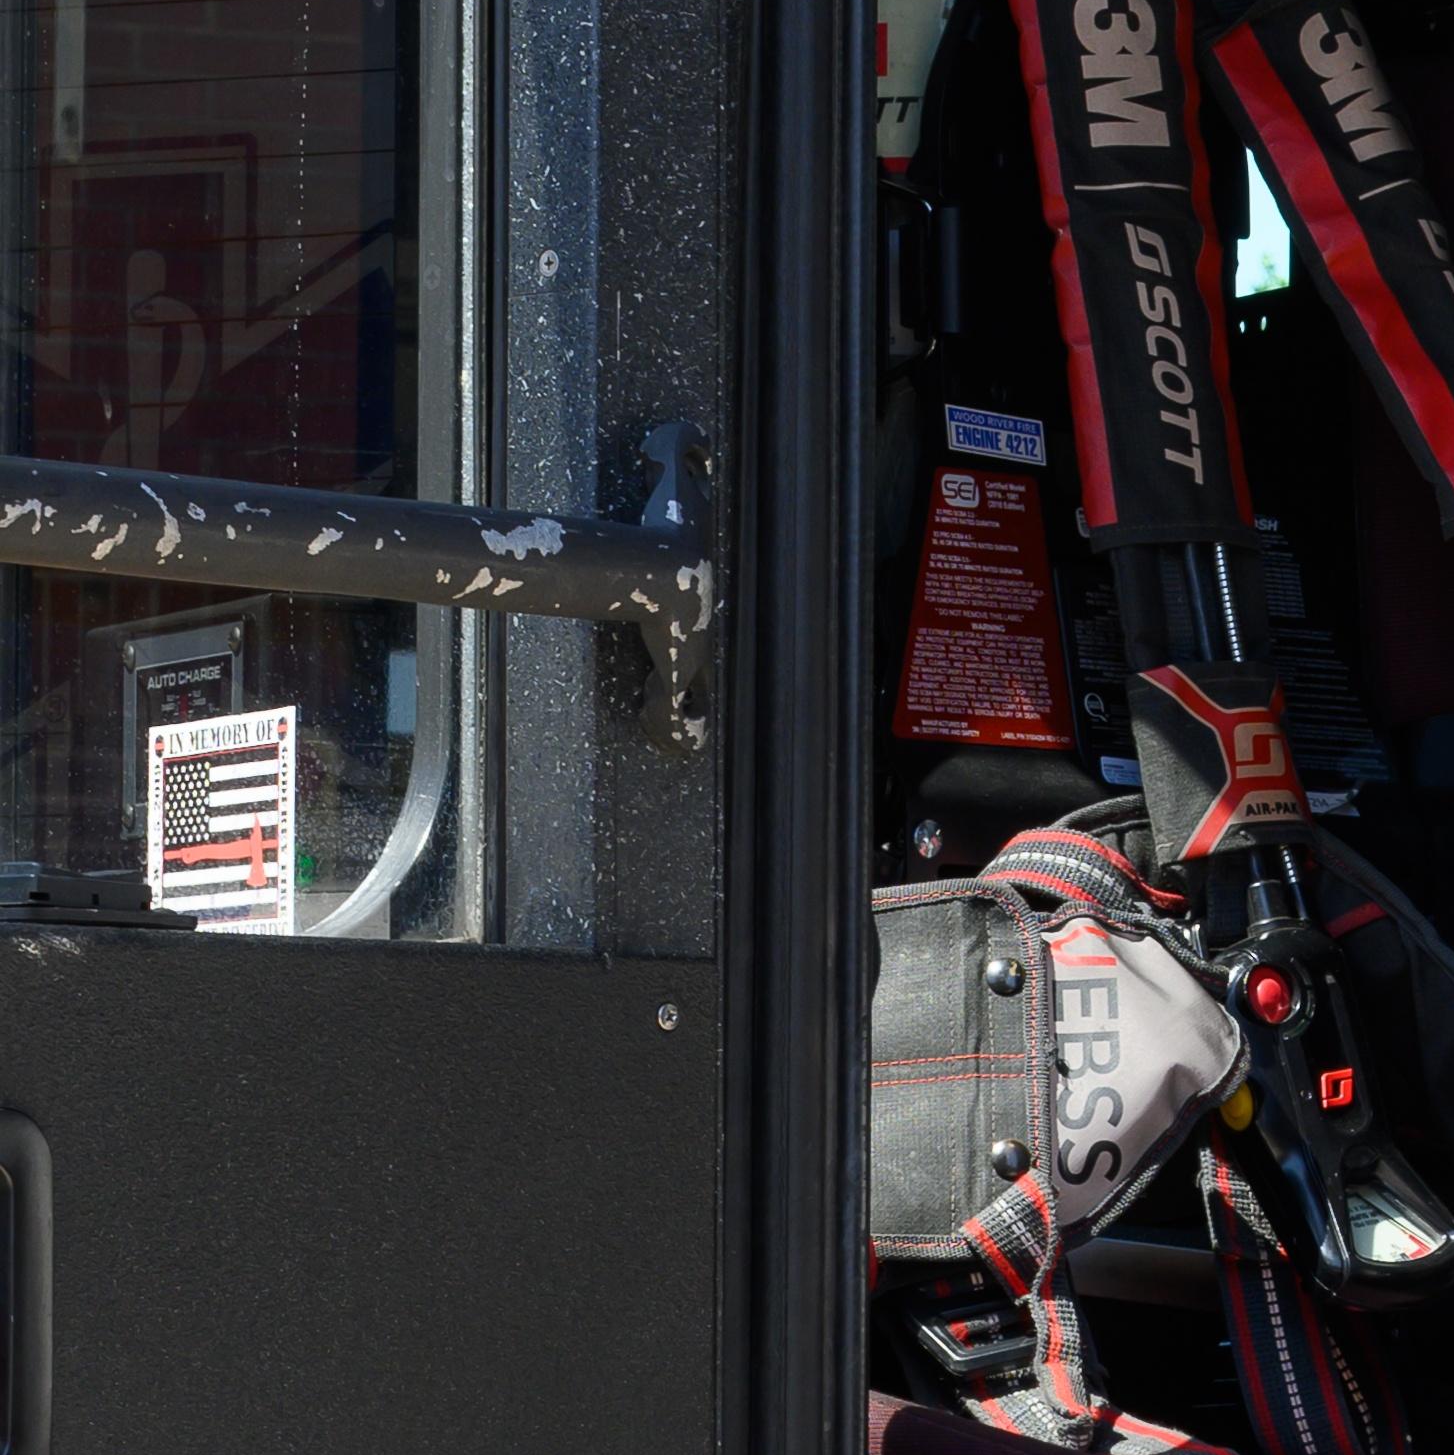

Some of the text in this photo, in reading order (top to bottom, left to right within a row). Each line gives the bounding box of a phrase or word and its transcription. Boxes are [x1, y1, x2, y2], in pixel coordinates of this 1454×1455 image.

[1298, 7, 1416, 165] 3M
[1138, 280, 1206, 486] SCOTT
[952, 411, 1038, 434] WOOD RIVER FIRE
[955, 424, 1038, 458] ENGINE 4212
[943, 480, 976, 501] SEI
[147, 665, 222, 690] AUTO CHARGE
[169, 718, 276, 755] IN MEMORY OF
[1245, 801, 1300, 817] AIR-PAK
